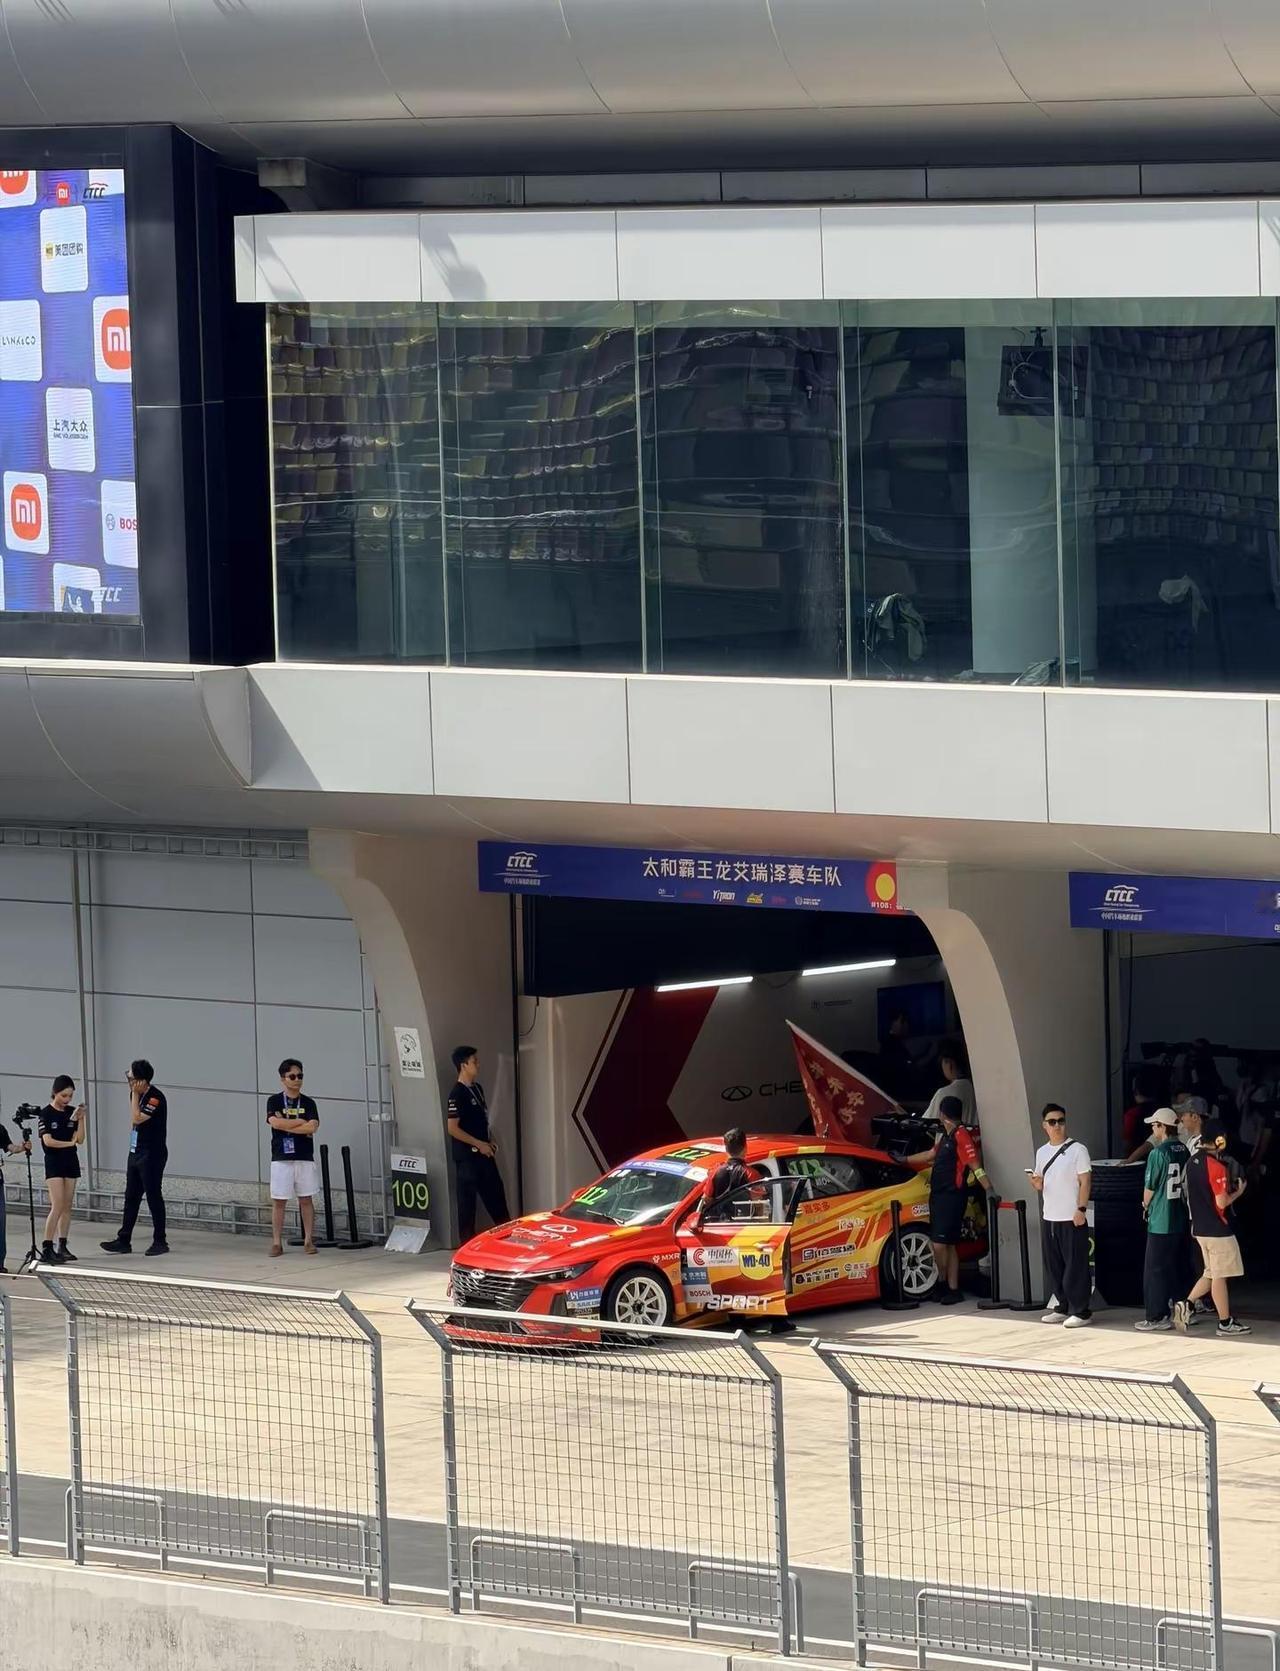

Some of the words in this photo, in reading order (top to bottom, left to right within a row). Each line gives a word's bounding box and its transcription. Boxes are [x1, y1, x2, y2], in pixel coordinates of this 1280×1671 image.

[53, 419, 88, 432] 上汽大众
[507, 856, 534, 868] CTCC
[642, 856, 842, 887] 太和霸王龙艾瑞泽赛车队
[1105, 889, 1135, 903] CTCC
[399, 1159, 417, 1169] CTCC
[392, 1179, 430, 1211] 109
[574, 1186, 609, 1206] 112
[689, 1289, 711, 1298] BOSCH
